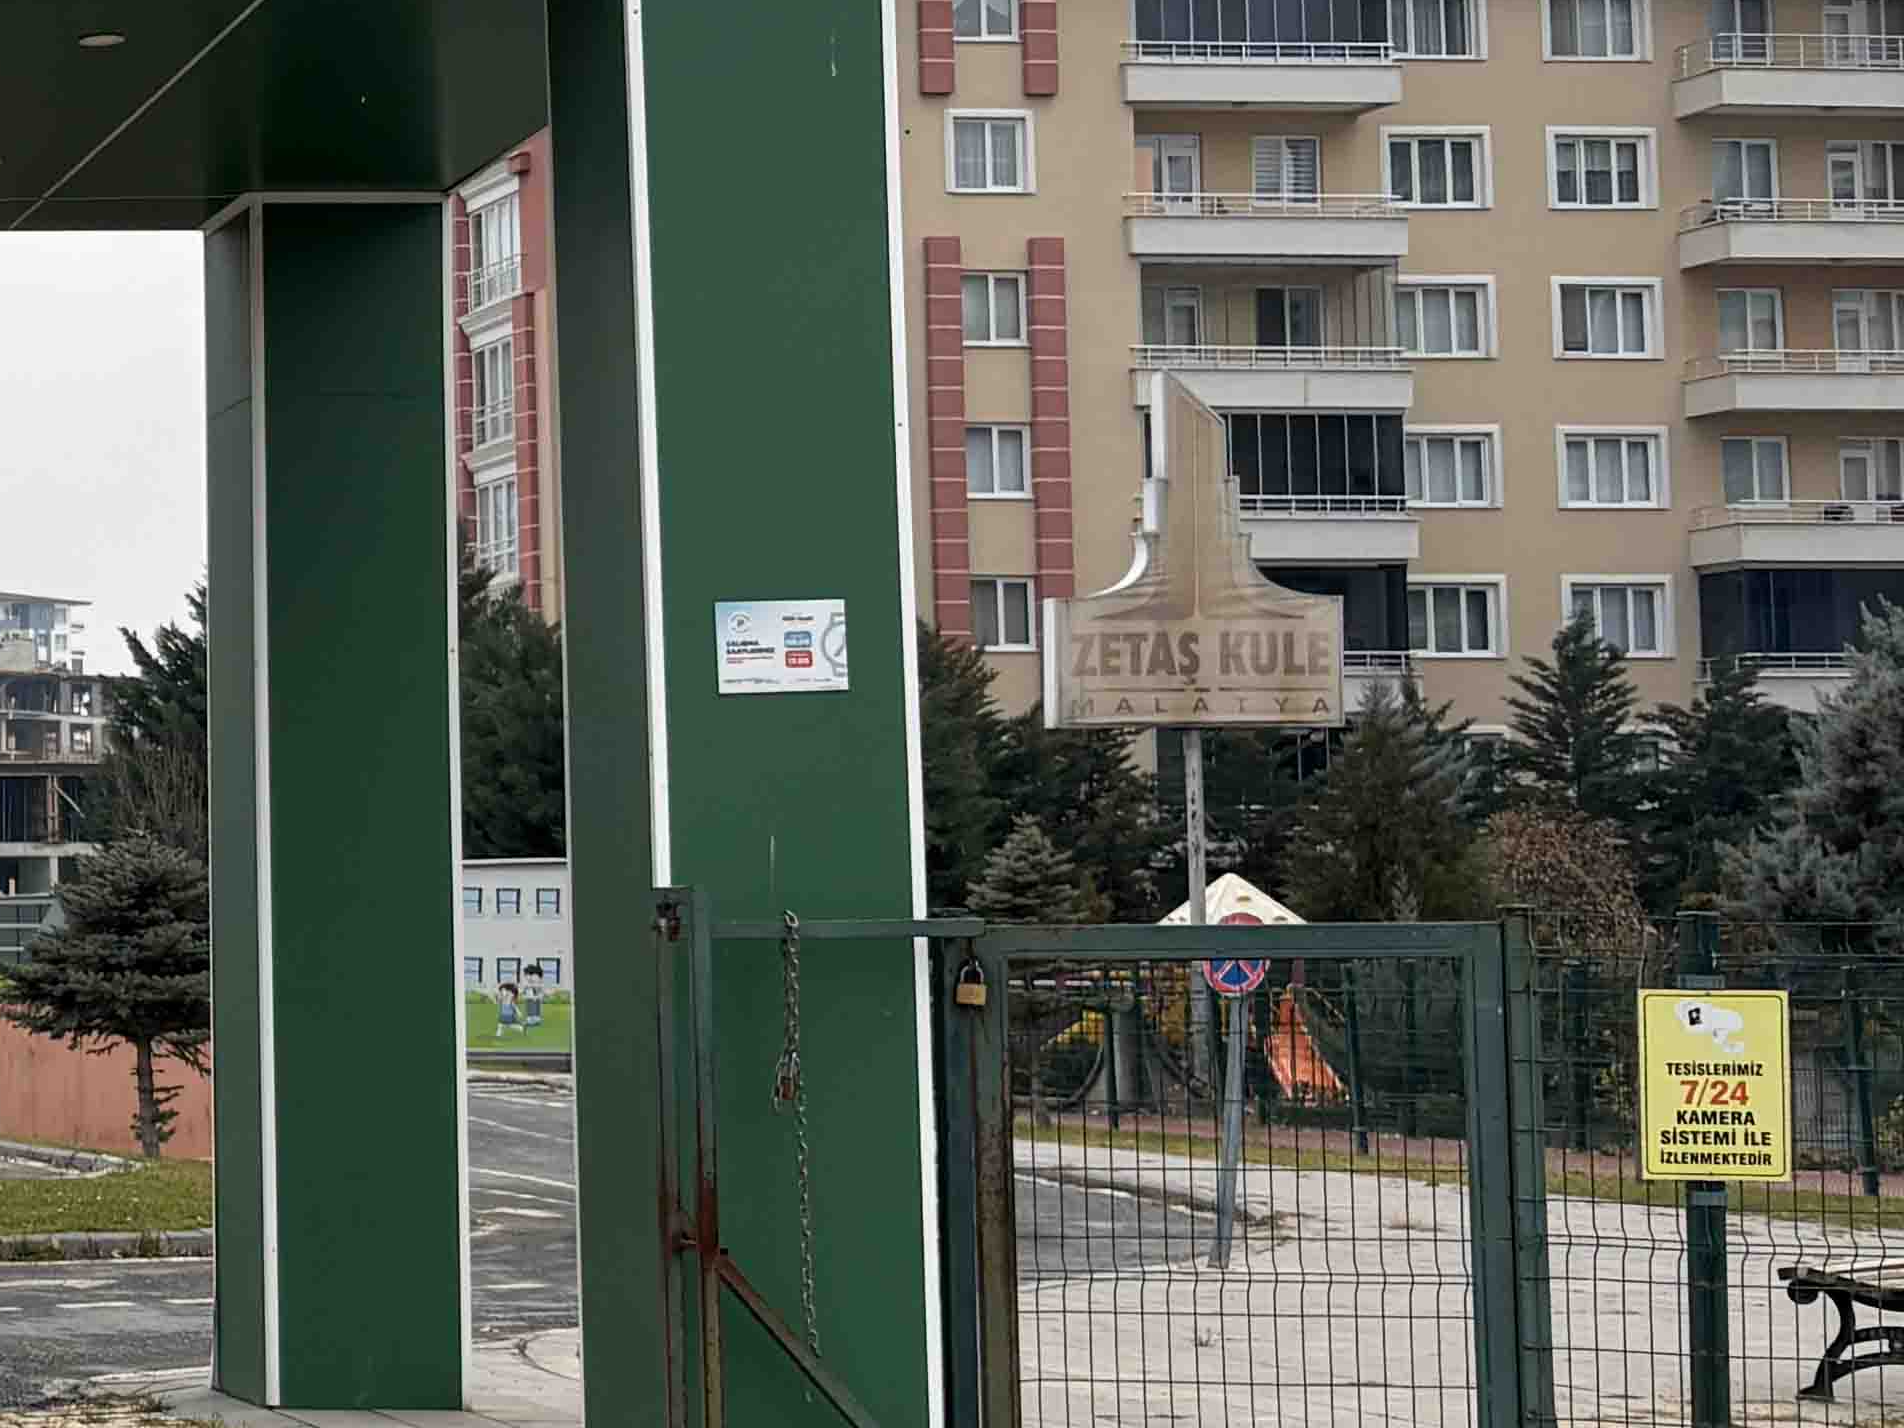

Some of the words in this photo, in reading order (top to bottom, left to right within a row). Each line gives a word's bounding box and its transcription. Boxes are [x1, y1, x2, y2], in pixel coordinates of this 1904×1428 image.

[1071, 630, 1200, 686] ZETAŞ
[1218, 630, 1330, 677] KULE
[1071, 697, 1330, 714] MALATYA
[1665, 1060, 1764, 1076] TESİSLERİMİZ
[1679, 1078, 1750, 1108] 7/24
[1676, 1110, 1756, 1126] KAMERA
[1660, 1126, 1736, 1146] SİSTEMİ
[1743, 1128, 1772, 1146] İLE
[1660, 1148, 1772, 1166] İZLENMEKTEDİR
